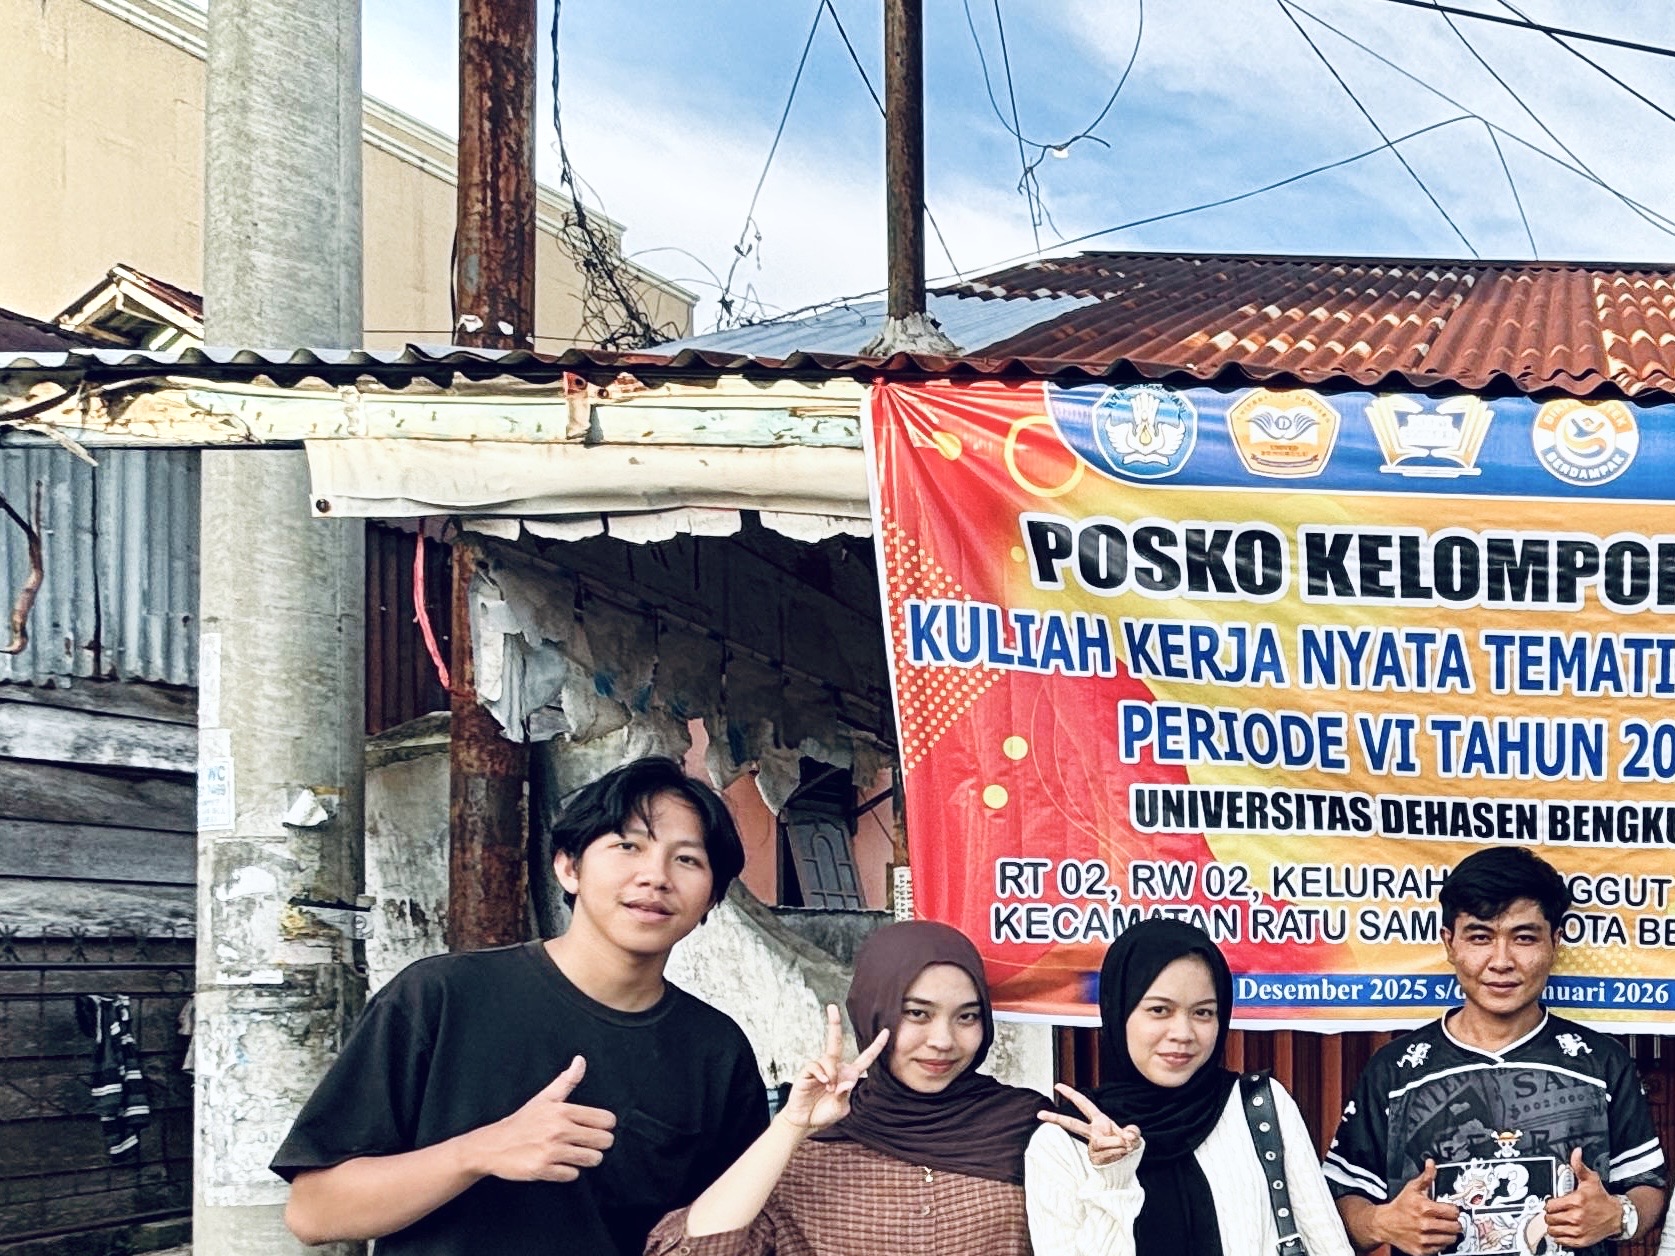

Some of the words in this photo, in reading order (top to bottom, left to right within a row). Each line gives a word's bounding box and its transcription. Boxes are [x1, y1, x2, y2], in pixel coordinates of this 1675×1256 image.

[1545, 451, 1625, 480] BERDAMPAK
[1026, 519, 1283, 596] POSKO
[909, 603, 1112, 674] KULIAH
[1124, 621, 1286, 684] KERJA
[1302, 628, 1471, 689] NYATA
[1122, 704, 1345, 769] PERIODE
[1358, 717, 1416, 772] VI
[1430, 719, 1604, 777] TAHUN
[1134, 788, 1373, 833] UNIVERSITAS
[1380, 798, 1538, 840] DEHASEN
[999, 861, 1049, 895] RT
[1060, 862, 1118, 902] 02,
[1132, 864, 1194, 897] RW
[1204, 865, 1260, 903] 02,
[1272, 865, 1449, 899] KELURAH
[1566, 875, 1673, 908] GGUT
[1251, 909, 1347, 942] RATU
[1359, 910, 1437, 942] SAM
[1560, 913, 1627, 946] OTA
[1238, 977, 1364, 1001] Desember
[1369, 977, 1429, 1001] 2025
[1541, 981, 1607, 1003] nuari
[1612, 982, 1670, 1005] 2026
